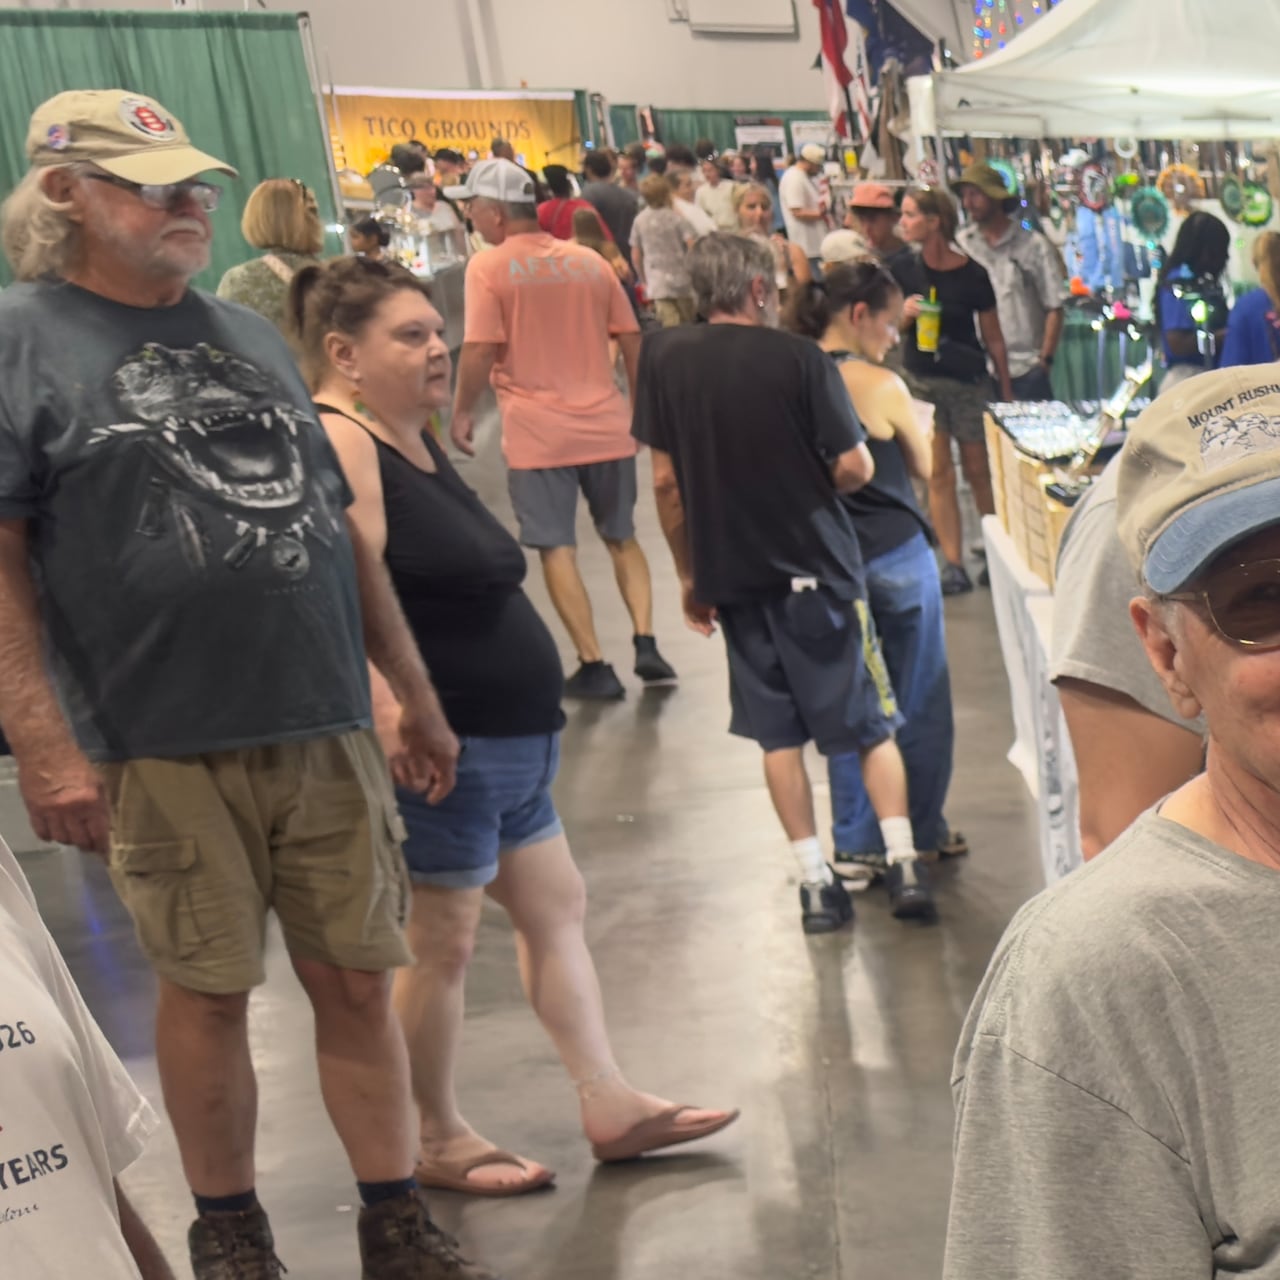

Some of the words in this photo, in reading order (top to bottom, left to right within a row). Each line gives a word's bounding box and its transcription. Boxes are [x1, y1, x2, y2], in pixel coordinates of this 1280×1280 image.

[363, 117, 416, 138] TICO
[1187, 398, 1235, 430] MOUNT
[0, 1021, 36, 1050] 26
